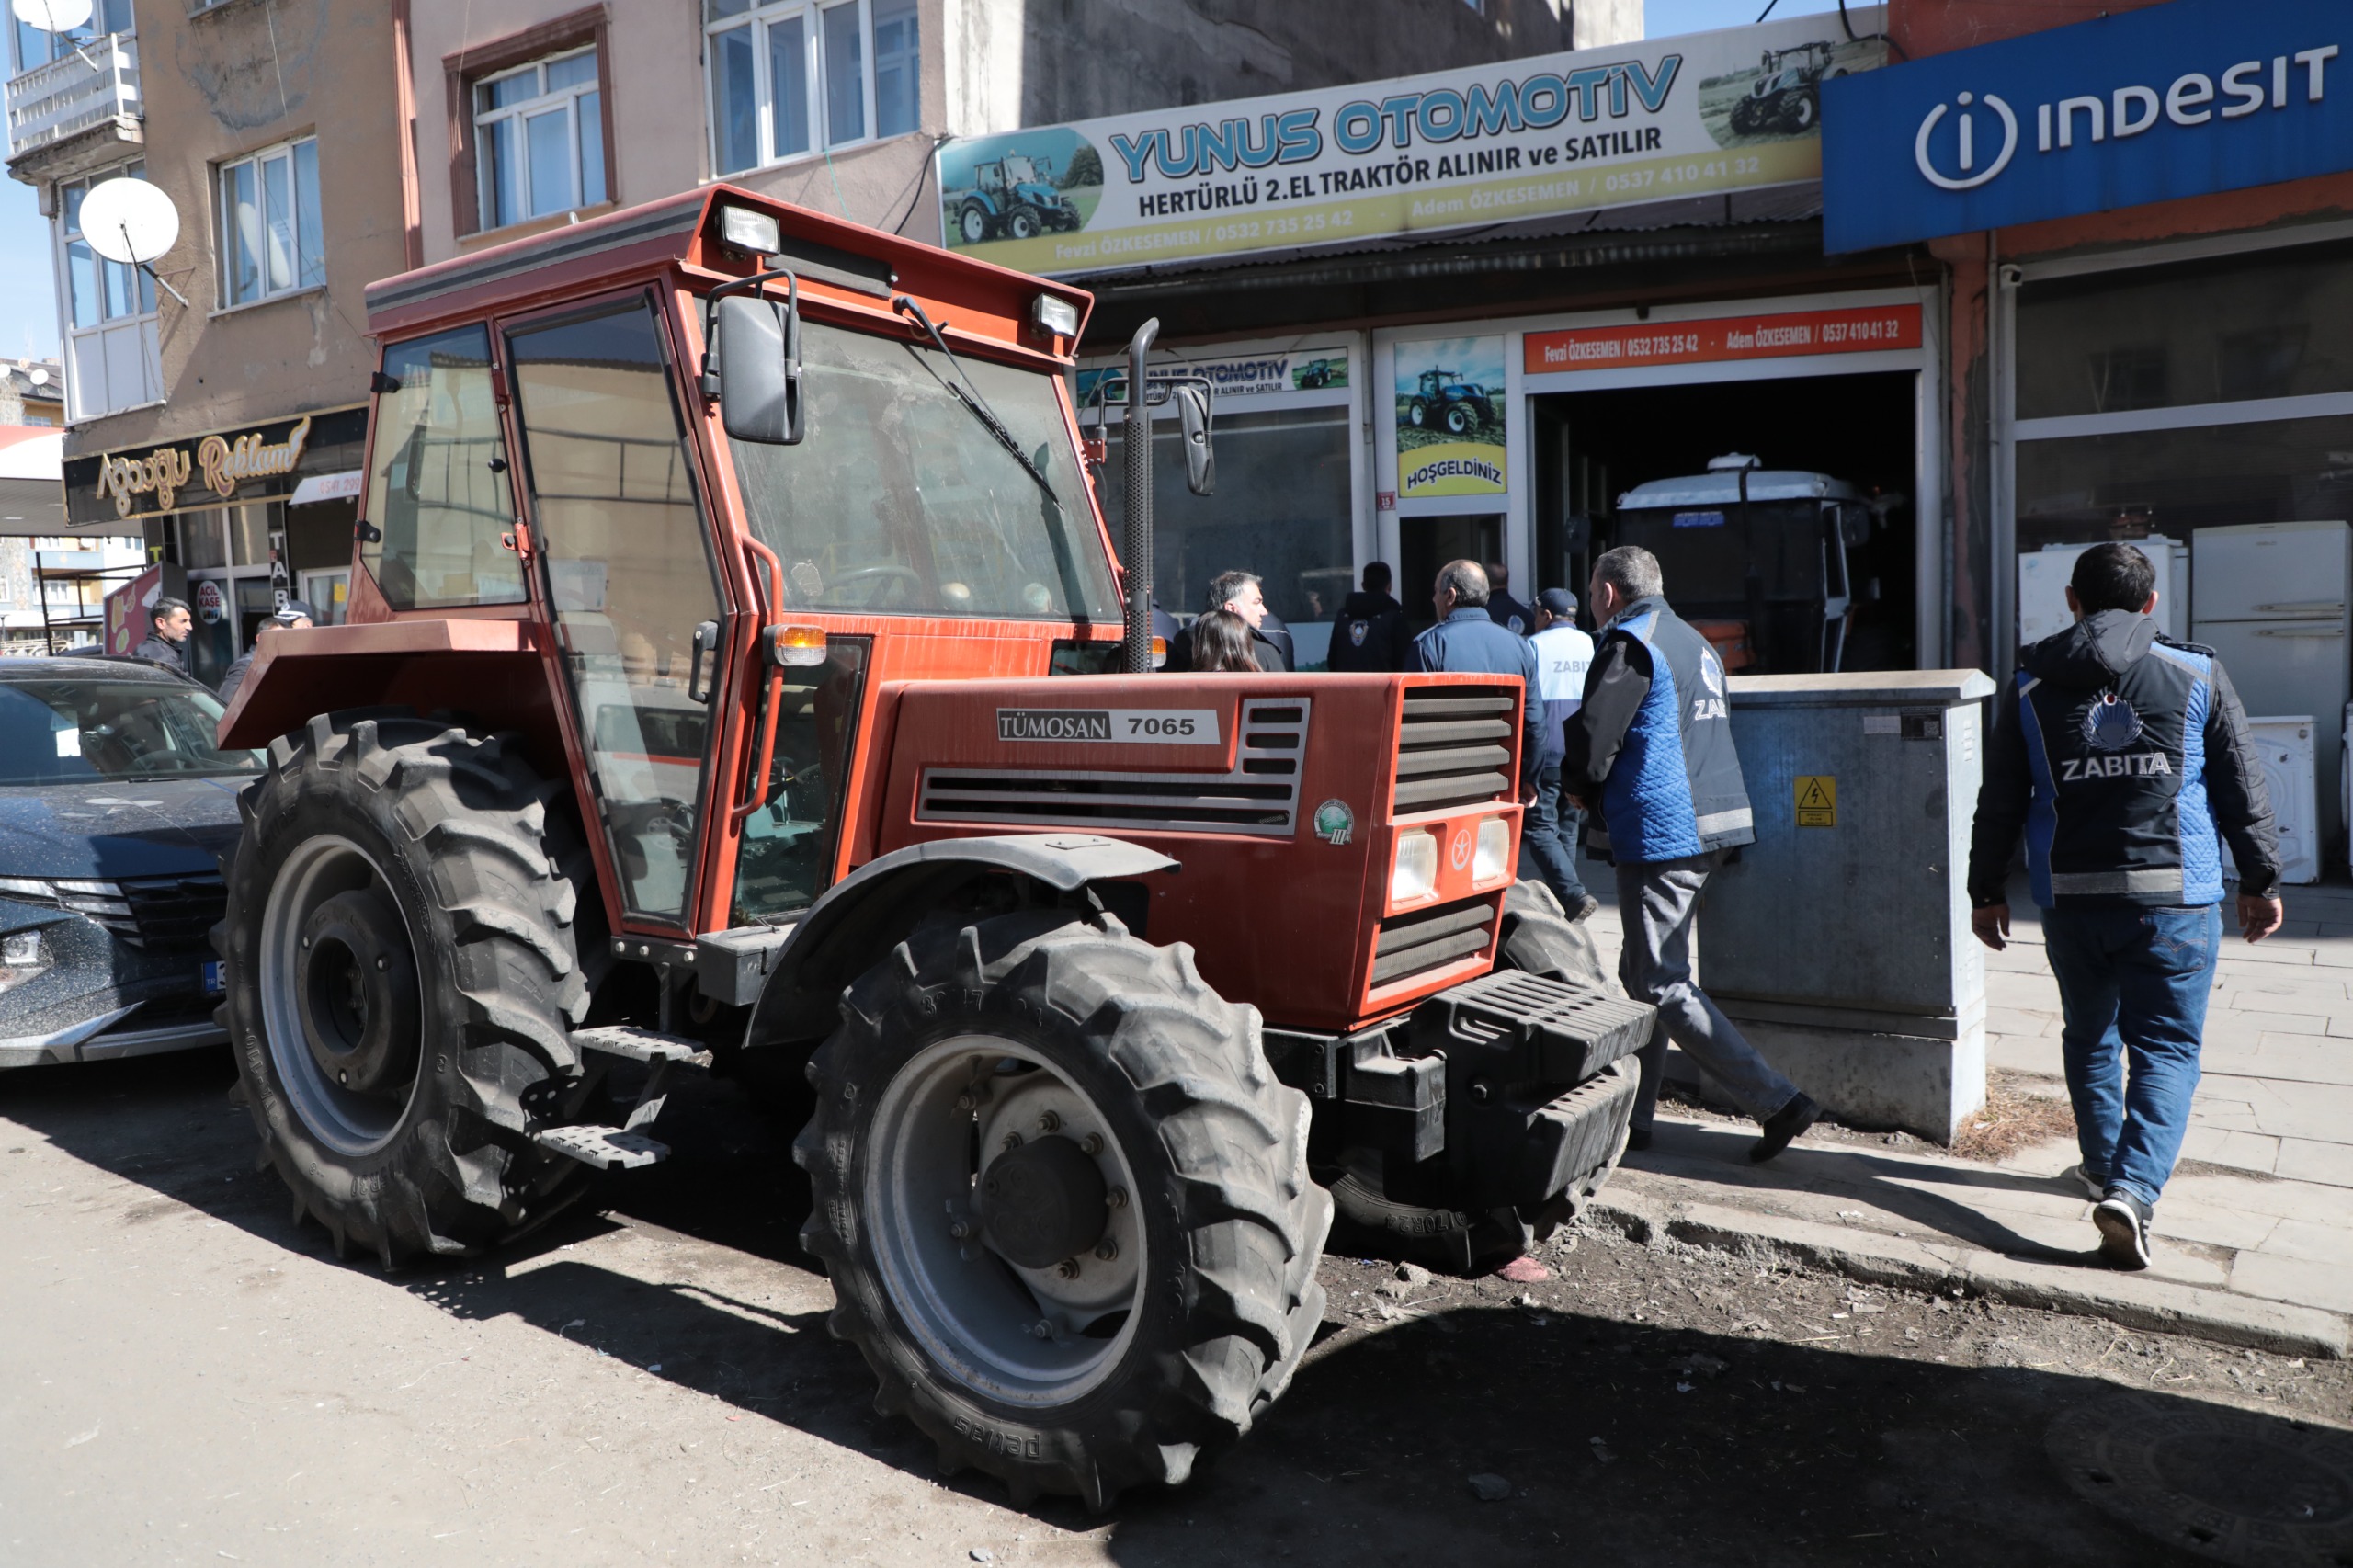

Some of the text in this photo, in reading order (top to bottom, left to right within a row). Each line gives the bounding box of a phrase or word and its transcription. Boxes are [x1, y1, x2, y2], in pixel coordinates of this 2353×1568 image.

[1109, 53, 1683, 184] YUNUS OTOMOTİV
[1139, 176, 1258, 217] HERTÜRLÜ
[1321, 154, 1430, 194] TRAKTÖR
[1438, 151, 1522, 179] ALINIR
[1529, 146, 1558, 166] ve
[1565, 126, 1662, 162] SATILIR
[1055, 239, 1097, 260] Fevzi
[1100, 229, 1200, 256] ÖZKESEMEN
[1215, 222, 1260, 242] 0532
[1266, 217, 1300, 236] 735
[1302, 214, 1326, 233] 25
[1330, 210, 1354, 228] 42
[1412, 197, 1465, 218] Adem
[1470, 179, 1580, 210] ÖZKESEMEN
[1605, 170, 1654, 193] 0537
[1660, 165, 1699, 186] 410
[1703, 161, 1727, 180] 41
[1734, 156, 1760, 175] 32
[1569, 338, 1621, 361] ÖZKESEMEN
[1627, 338, 1652, 358] 0532
[1653, 336, 1670, 355] 735
[1671, 335, 1685, 354] 25
[1685, 334, 1699, 352] 42
[1727, 330, 1755, 349] Adem
[1756, 324, 1812, 347] ÖZKESEMEN
[1823, 322, 1847, 342] 0537
[1849, 321, 1870, 340] 410
[1870, 320, 1884, 339] 41
[1885, 319, 1899, 338] 32
[198, 415, 311, 497] Reklam
[1406, 457, 1504, 491] HOŞGELDİNİZ
[1381, 496, 1391, 506] 15
[999, 711, 1196, 741] TÜMOSAN 7065
[2060, 751, 2172, 781] ZABITA
[206, 977, 217, 986] TR
[952, 1414, 1042, 1459] petlas
